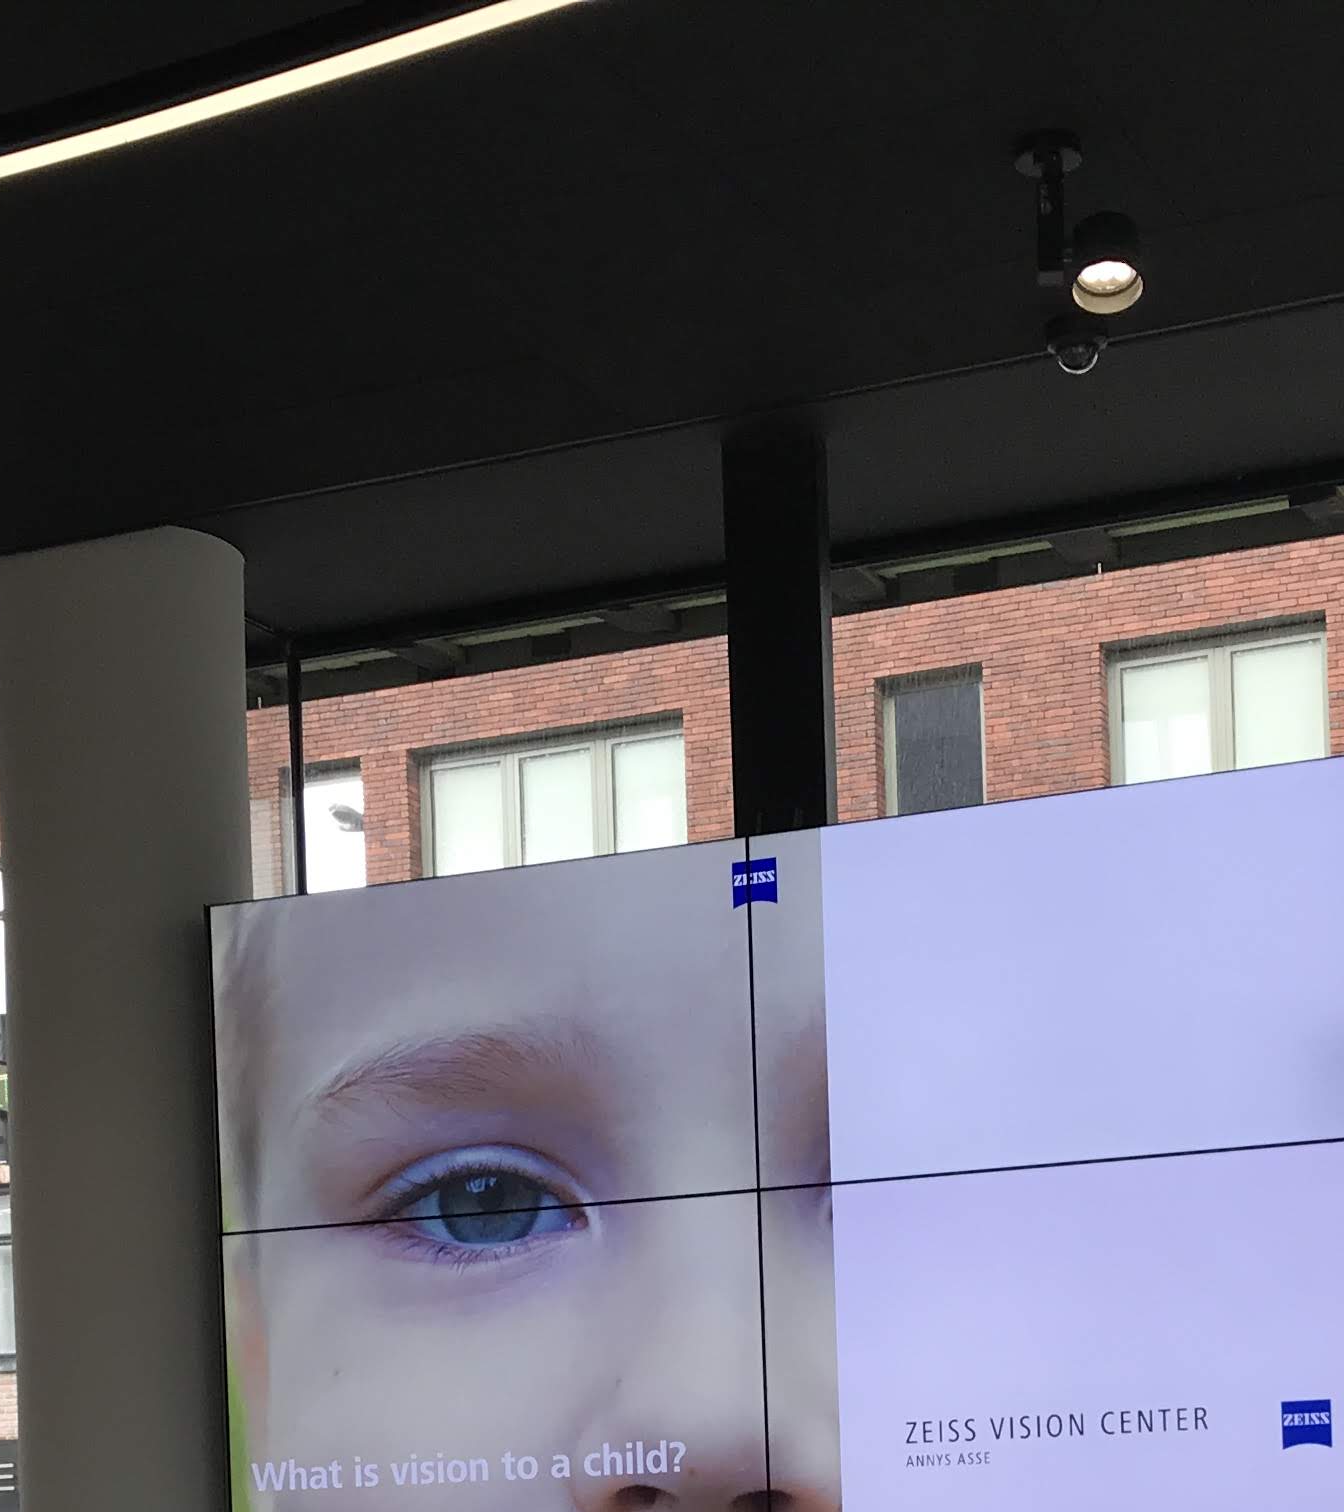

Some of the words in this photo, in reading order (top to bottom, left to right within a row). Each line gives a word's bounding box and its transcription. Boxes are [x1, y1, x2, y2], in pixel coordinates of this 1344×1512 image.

[905, 1419, 977, 1444] ZEISS
[990, 1413, 1085, 1440] VISION
[1100, 1406, 1209, 1436] CENTER
[1282, 1411, 1331, 1426] ZEISS
[252, 1458, 343, 1492] What
[355, 1456, 379, 1488] is
[390, 1453, 489, 1486] vision
[501, 1449, 538, 1480] to
[552, 1453, 571, 1479] a
[583, 1441, 687, 1478] child?
[905, 1453, 952, 1468] ANNYS
[957, 1451, 991, 1465] ASSE
